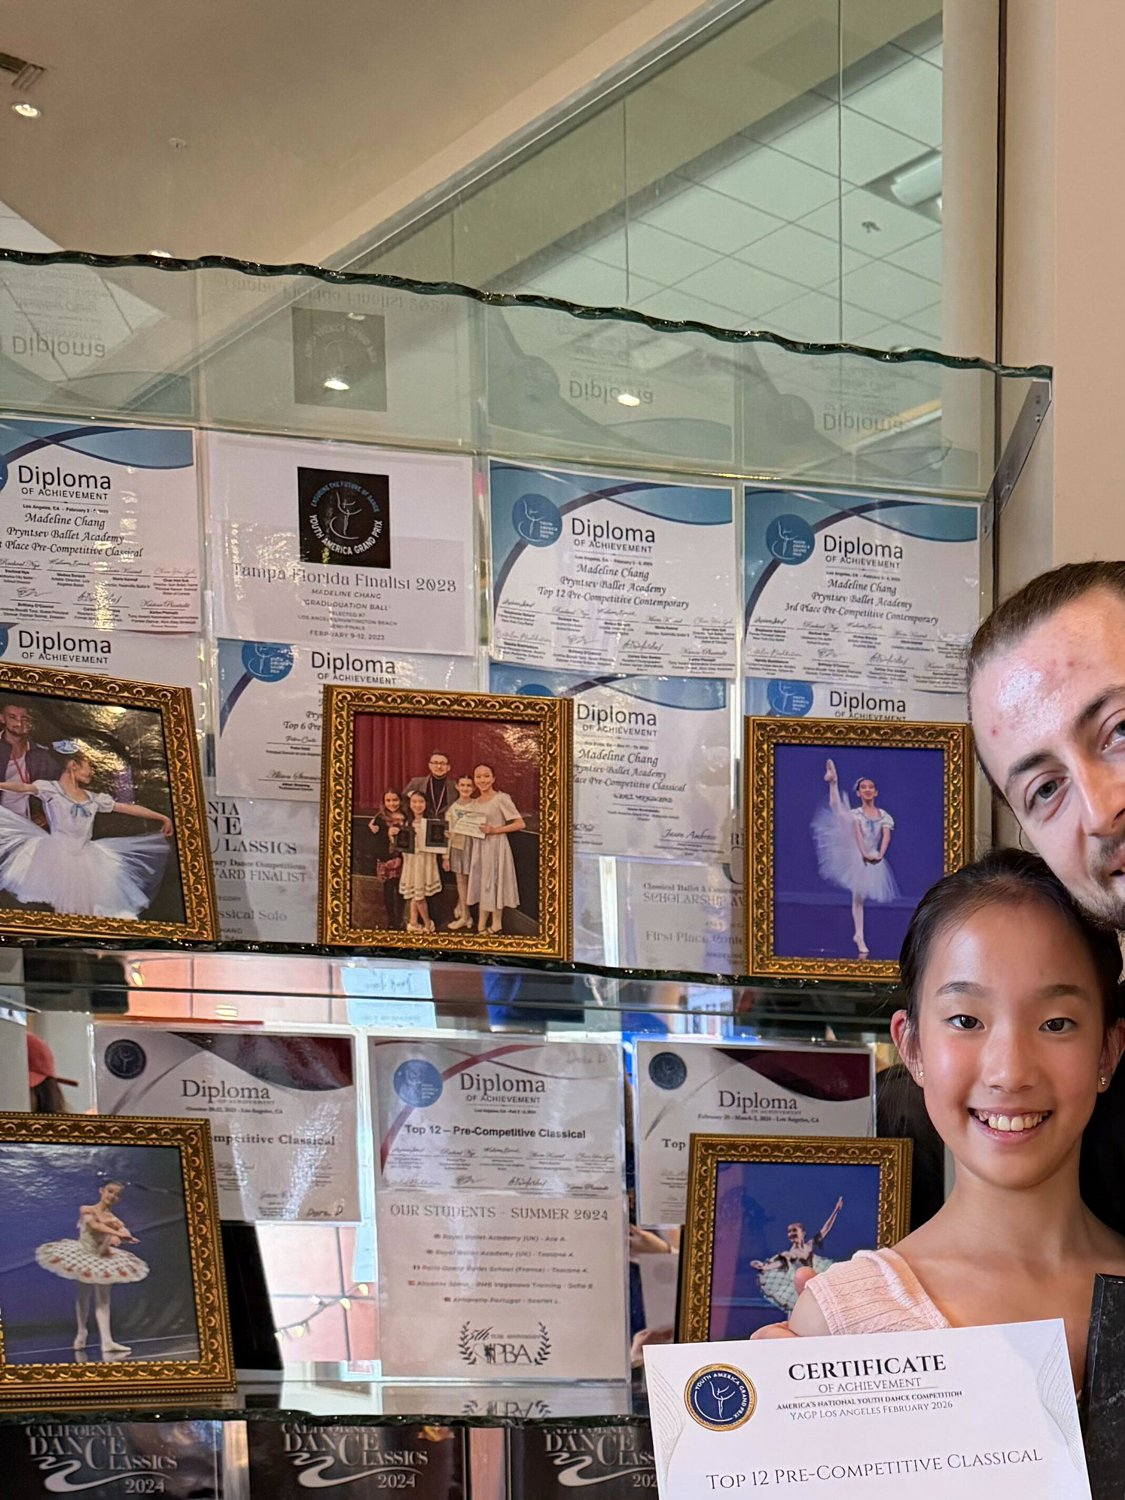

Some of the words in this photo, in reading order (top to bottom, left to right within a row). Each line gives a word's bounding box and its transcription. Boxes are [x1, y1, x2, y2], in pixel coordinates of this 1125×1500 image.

[19, 465, 111, 490] Diploma
[38, 489, 108, 500] ACHIEVEMENT
[25, 513, 71, 525] Madeline
[74, 517, 105, 529] Chang
[7, 527, 49, 539] Pryntsev
[51, 531, 79, 540] Ballet
[81, 532, 124, 545] Academy
[572, 517, 655, 543] Diploma
[5, 540, 29, 550] Place
[31, 543, 102, 555] Pre-Competitive
[589, 541, 653, 553] ACHIEVEMENT
[824, 535, 903, 559] Diploma
[840, 557, 900, 569] ACHIEVEMENT
[576, 564, 618, 577] Madeline
[621, 568, 649, 581] Chang
[356, 574, 410, 589] Finalist
[416, 578, 456, 592] 2023
[560, 576, 598, 588] Pryntsev
[600, 579, 626, 590] Ballet
[628, 583, 666, 595] Academy
[828, 579, 867, 591] Madeline
[870, 583, 897, 596] Chang
[312, 589, 352, 598] MADELINE
[354, 591, 381, 599] CHANG
[538, 587, 553, 598] Top
[556, 589, 565, 598] 12
[567, 591, 631, 604] Pre-Competitive
[633, 596, 689, 609] Contemporary
[785, 602, 798, 612] 3rd
[800, 604, 821, 613] Place
[823, 606, 883, 619] Pre-Competitive
[885, 611, 938, 626] Contemporary
[19, 630, 112, 653] Diploma
[37, 653, 108, 664] ACHIEVEMENT
[312, 652, 396, 674] Diploma
[333, 674, 396, 684] ACHIEVEMENT
[830, 691, 906, 712] Diploma
[577, 704, 657, 726] Diploma
[579, 749, 624, 762] Madeline
[628, 752, 658, 766] Chang
[251, 870, 305, 882] FINALIST
[258, 909, 287, 921] Solo
[646, 931, 673, 942] First
[181, 1079, 270, 1103] Diploma
[461, 1073, 546, 1094] Diploma
[719, 1091, 798, 1113] Diploma
[279, 1135, 335, 1146] Classical
[406, 1125, 425, 1135] Top
[430, 1126, 441, 1135] 12
[453, 1126, 536, 1138] Pre-Competitive
[539, 1128, 585, 1139] Classical
[662, 1139, 686, 1150] Top
[391, 1204, 419, 1216] OUR
[424, 1205, 496, 1218] STUDENTS
[511, 1208, 568, 1220] SUMMER
[574, 1209, 608, 1221] 2024
[788, 1355, 946, 1381] CERTIFICATE
[713, 1373, 740, 1385] AMERICA
[818, 1383, 835, 1394] OF
[837, 1378, 921, 1393] ACHIEVEMENT
[777, 1400, 815, 1410] AMERICA'S
[817, 1398, 856, 1407] NATIONAL
[857, 1396, 883, 1404] YOUTH
[885, 1394, 910, 1403] DANCE
[912, 1391, 962, 1400] COMPETITION
[790, 1410, 818, 1421] YAGP
[820, 1409, 837, 1419] LOS
[839, 1406, 881, 1417] ANGELES
[883, 1403, 928, 1414] FEBRUARY
[931, 1400, 953, 1410] 2026
[26, 1425, 124, 1437] CALIFORNIA
[706, 1474, 746, 1490] TOP
[752, 1470, 769, 1486] 12
[775, 1457, 942, 1485] PRE-COMPETITIVE
[947, 1449, 1043, 1469] CLASSICAL
[125, 1479, 164, 1494] 2024
[378, 1474, 416, 1488] 2024
